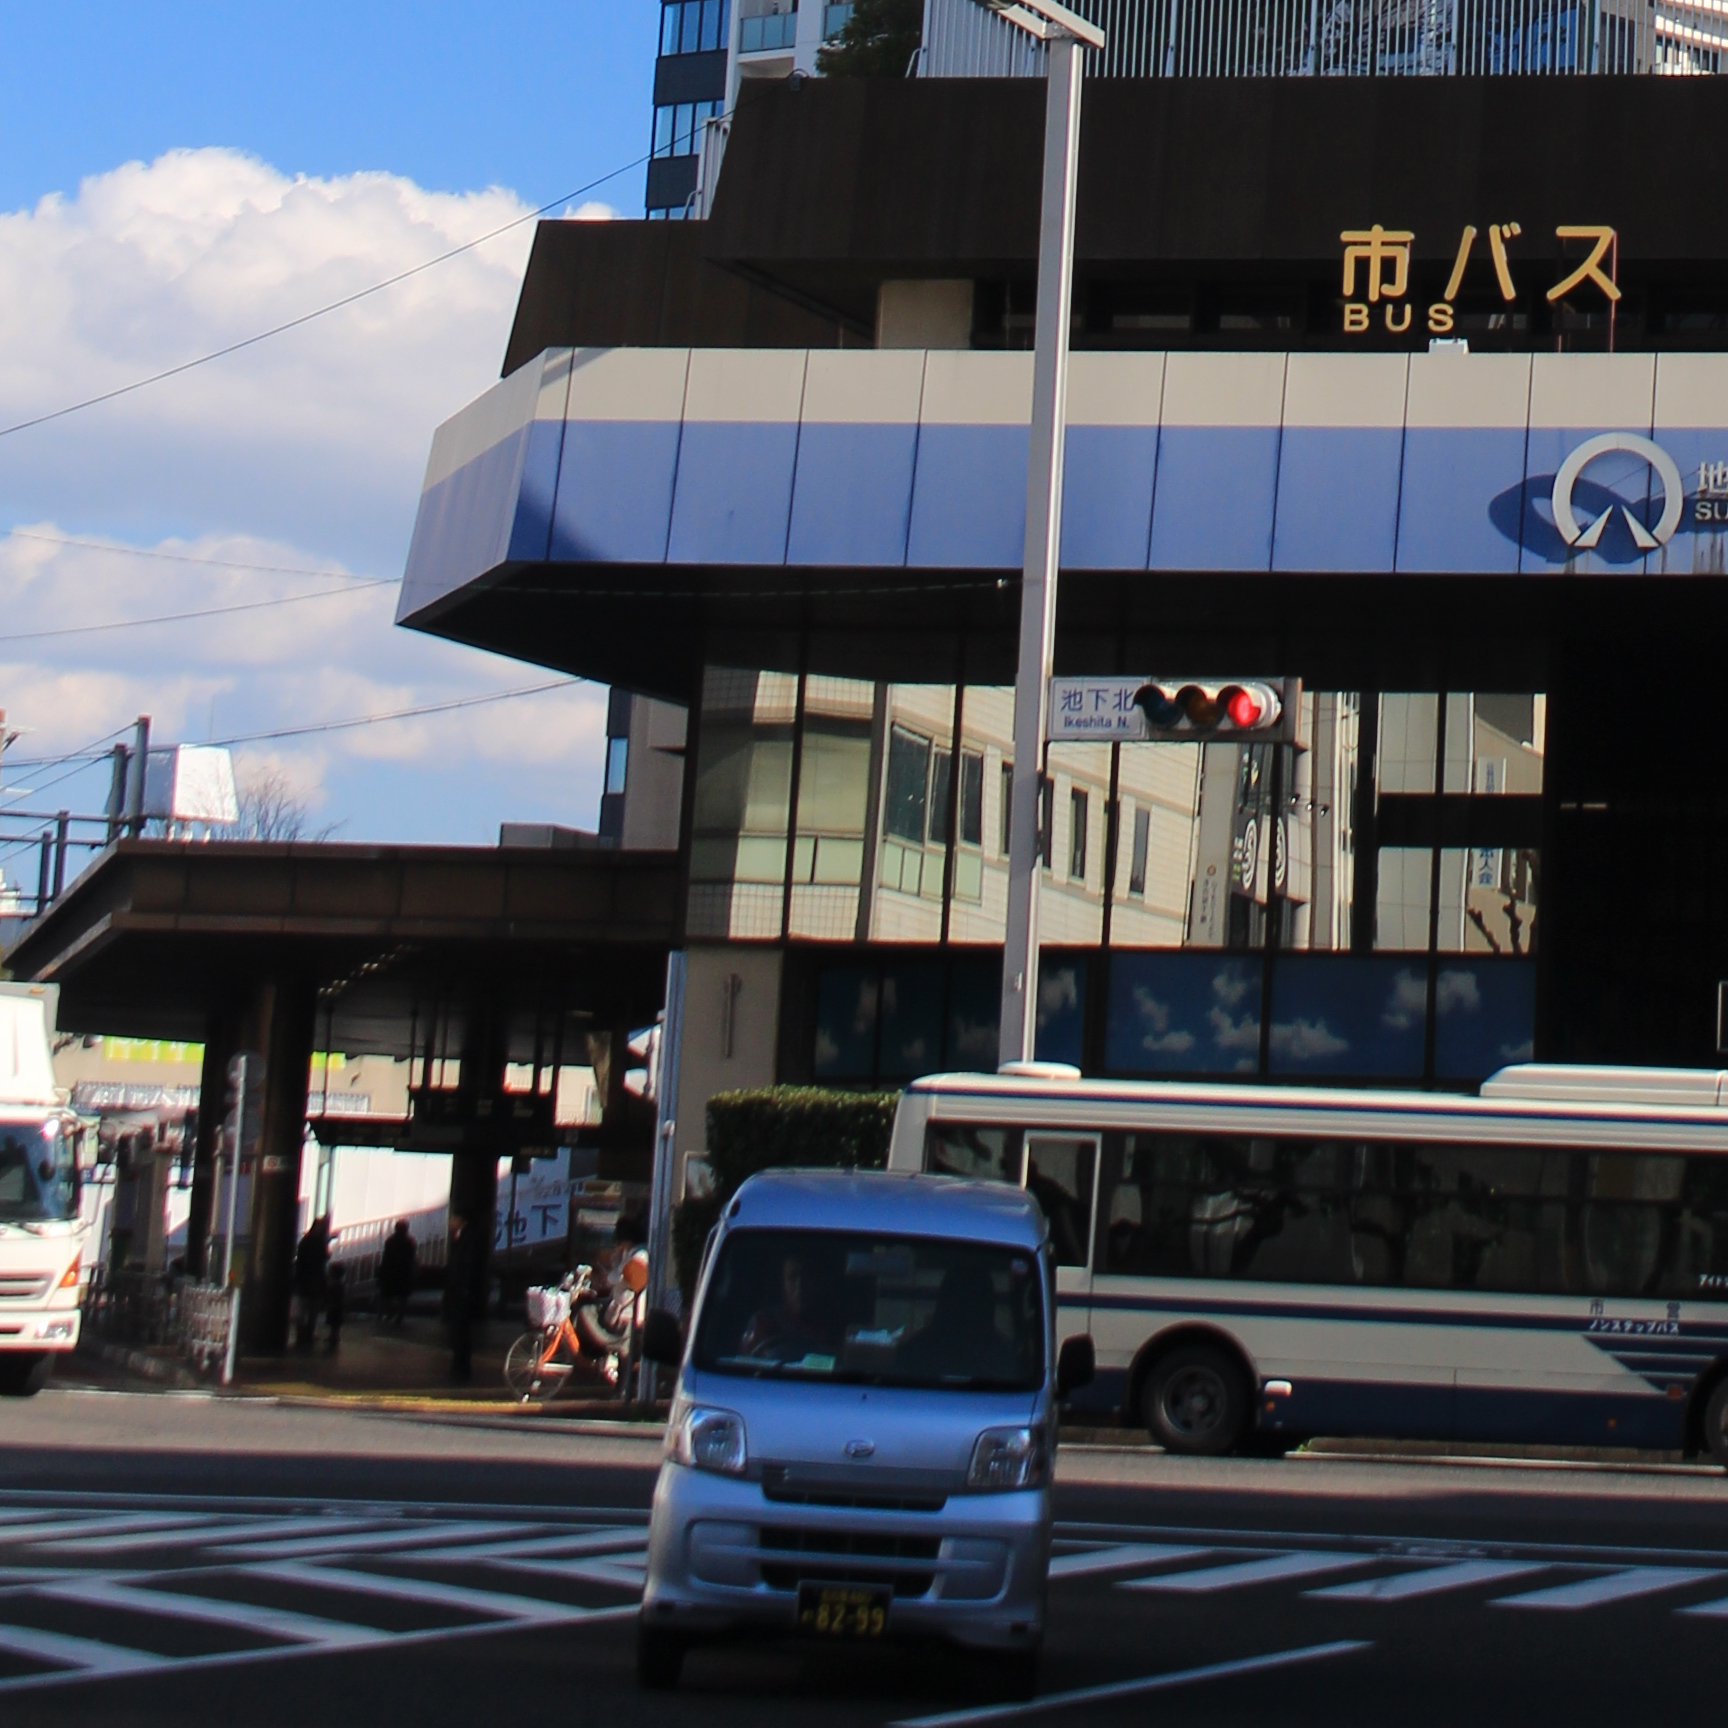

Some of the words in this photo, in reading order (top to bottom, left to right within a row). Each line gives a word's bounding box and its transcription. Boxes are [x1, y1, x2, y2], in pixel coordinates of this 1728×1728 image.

[1340, 221, 1622, 302] 市バス
[1343, 302, 1456, 333] BUS
[1060, 687, 1134, 712] 池下北
[1064, 715, 1112, 728] Ikeshita
[1117, 715, 1130, 728] N.
[1588, 1319, 1680, 1336] ノンステップバス
